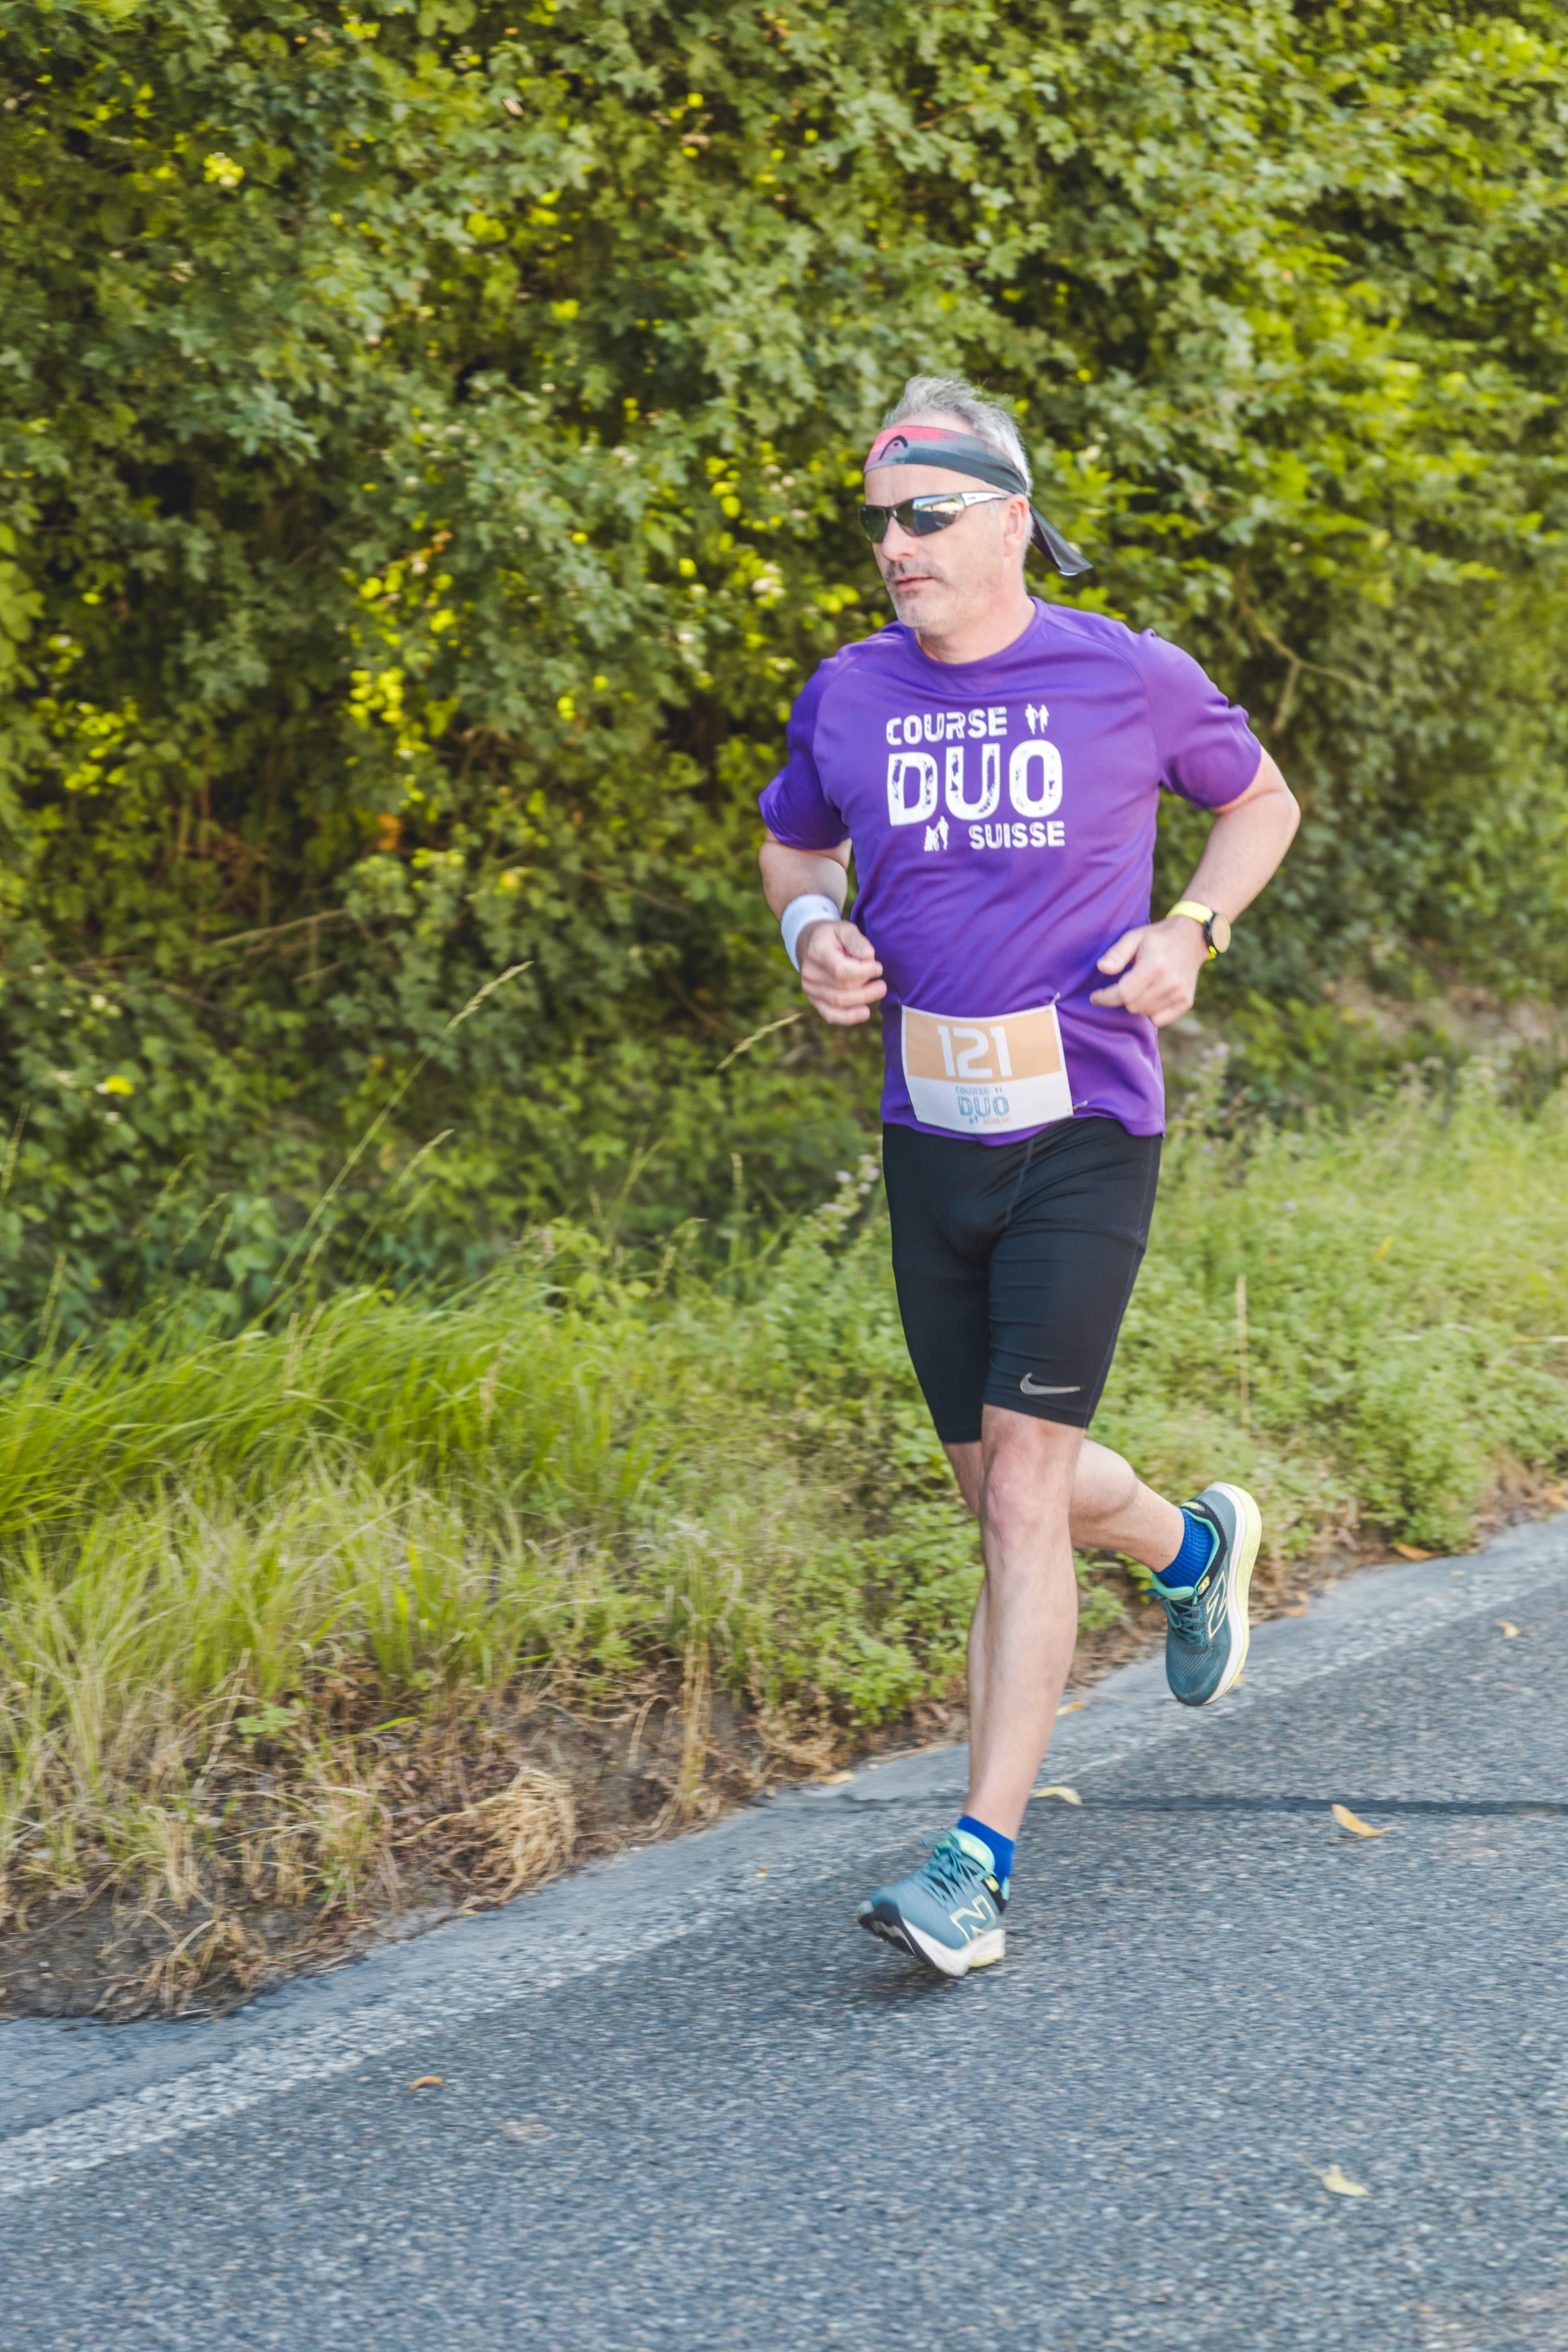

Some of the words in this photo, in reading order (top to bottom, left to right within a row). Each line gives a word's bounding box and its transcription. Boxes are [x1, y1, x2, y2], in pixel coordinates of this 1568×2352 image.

[886, 706, 1008, 746] COURSE
[887, 738, 1063, 827] DUO
[968, 820, 1066, 850] SUISSE
[937, 1024, 1013, 1079] 121
[957, 1095, 1010, 1117] DUO
